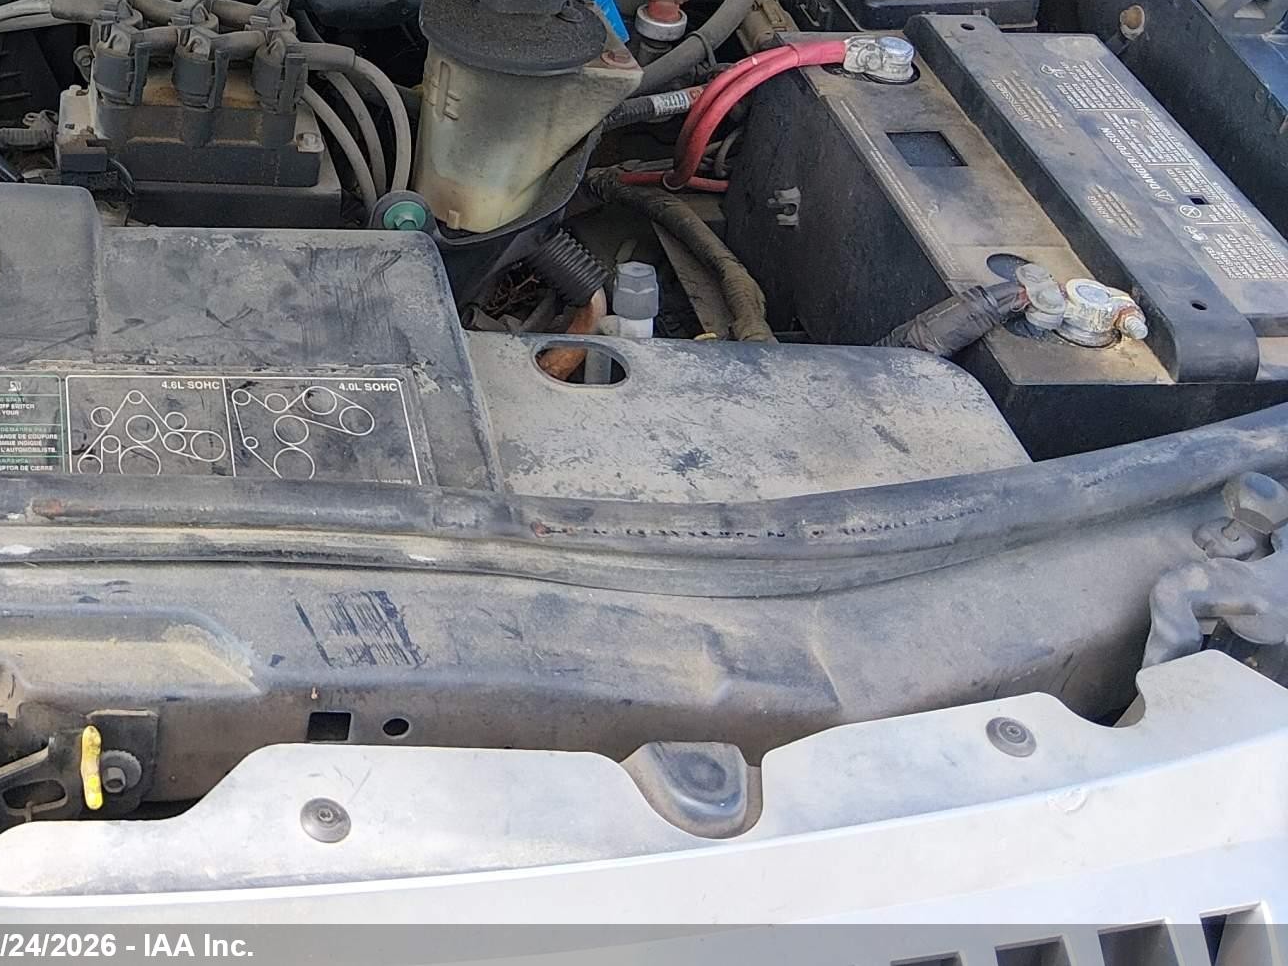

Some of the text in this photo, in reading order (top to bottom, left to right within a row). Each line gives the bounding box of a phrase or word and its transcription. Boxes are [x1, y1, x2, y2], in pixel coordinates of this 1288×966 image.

[1097, 126, 1163, 189] DANGER/POISON
[161, 381, 220, 390] 4.6L SOHC
[338, 383, 398, 391] 4.0L SOHC
